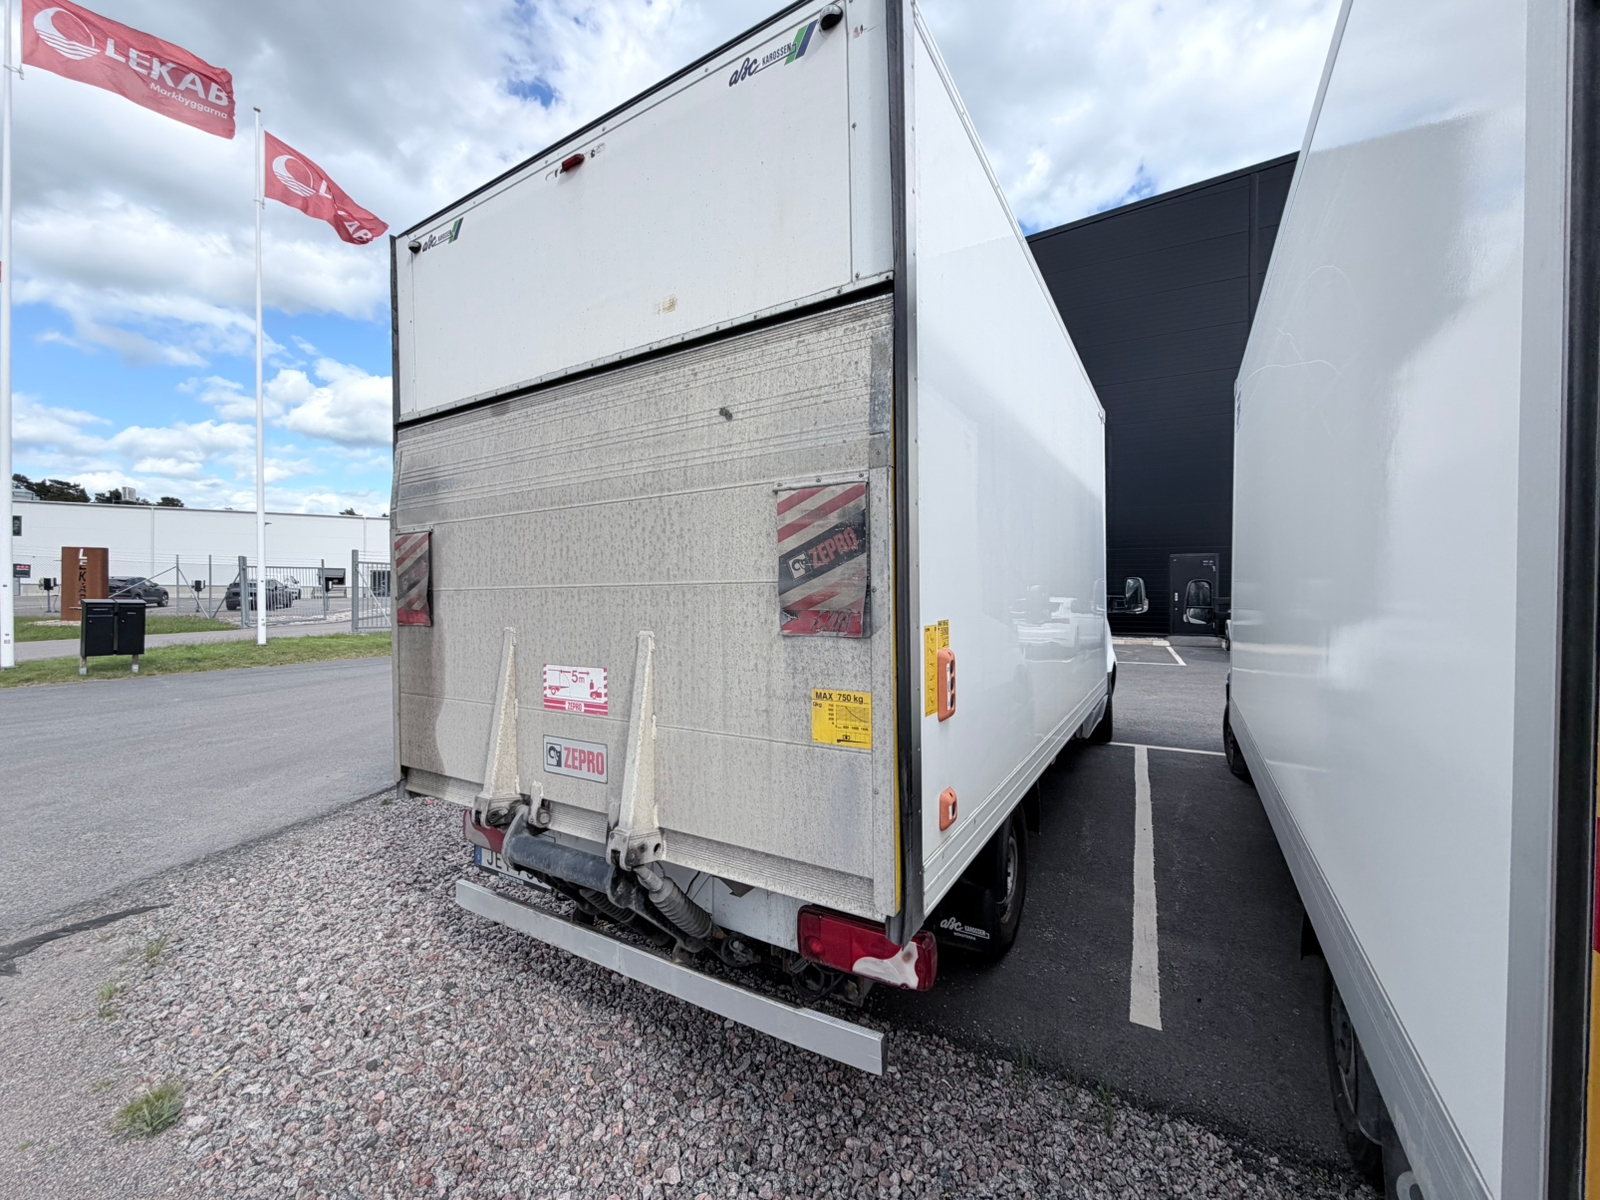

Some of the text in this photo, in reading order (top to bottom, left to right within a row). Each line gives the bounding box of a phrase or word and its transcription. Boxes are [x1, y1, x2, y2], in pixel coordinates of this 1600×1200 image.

[105, 38, 229, 107] LEKAB
[150, 82, 228, 119] Markbyggarna
[809, 527, 858, 569] ZEPRO
[571, 670, 579, 683] 5
[567, 702, 583, 712] ZEPRO
[815, 691, 864, 705] MAX 750 kg
[564, 746, 605, 776] ZEPRO
